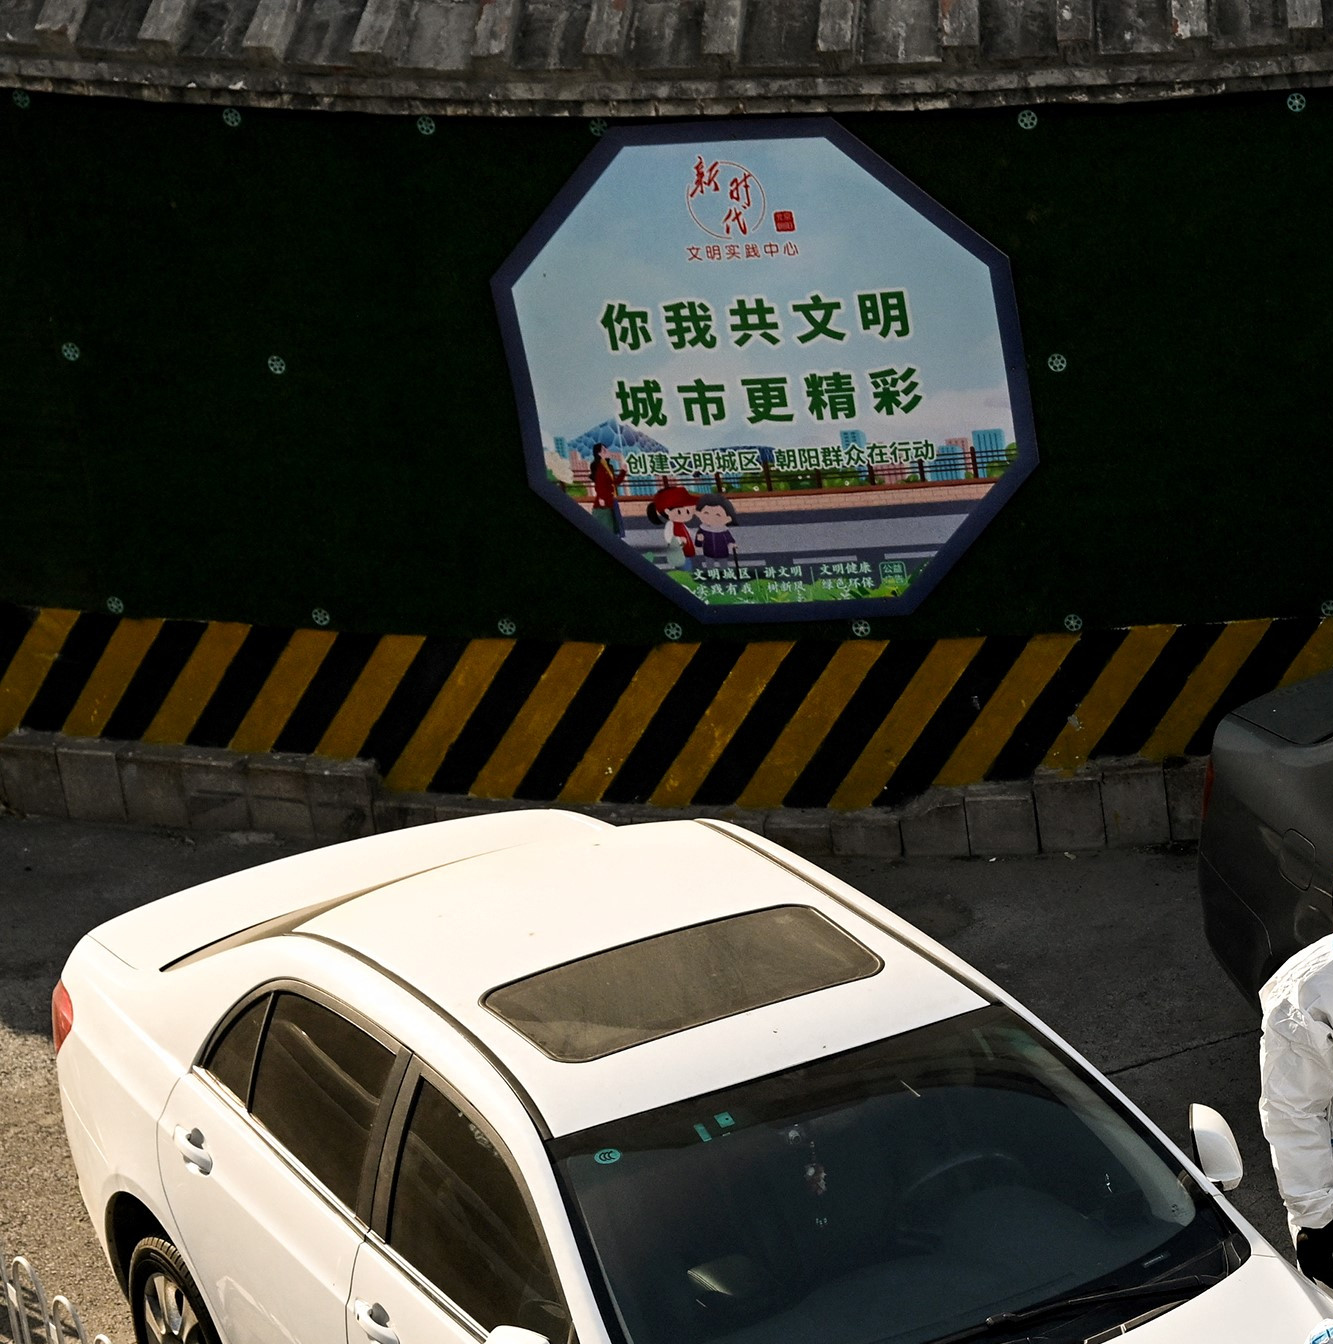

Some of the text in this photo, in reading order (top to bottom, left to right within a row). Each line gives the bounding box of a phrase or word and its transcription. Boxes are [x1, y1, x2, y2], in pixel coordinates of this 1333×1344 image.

[690, 156, 752, 235] 新时代
[687, 241, 798, 261] 文明实践中心
[600, 291, 910, 351] 你我共文明
[615, 367, 923, 427] 城市更精彩
[625, 440, 935, 475] 创建文明城区 朝阳群众在行动
[693, 567, 751, 581] 文明城区
[763, 565, 802, 579] 讲文明
[820, 562, 872, 575] 文明健康
[822, 576, 875, 591] 绿色环保
